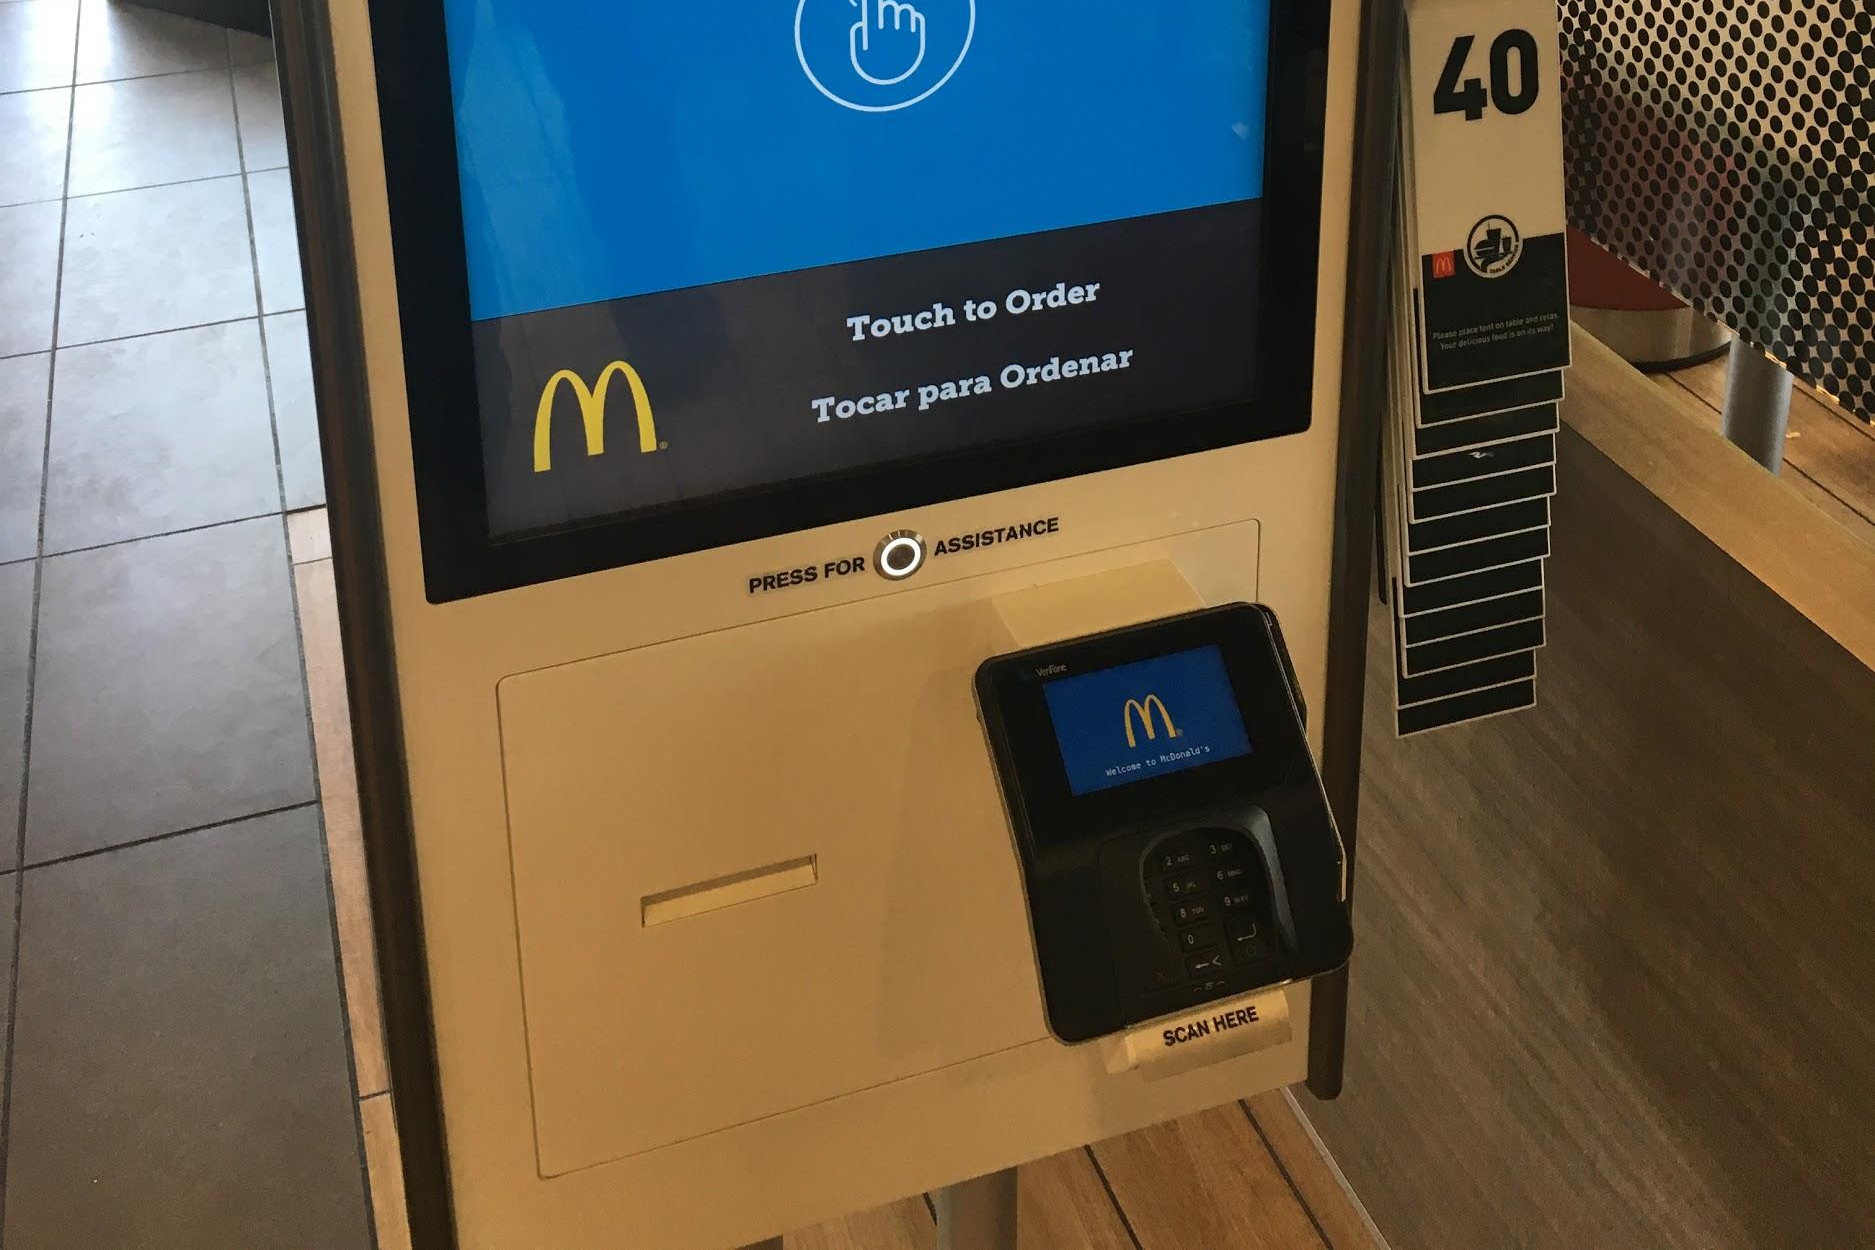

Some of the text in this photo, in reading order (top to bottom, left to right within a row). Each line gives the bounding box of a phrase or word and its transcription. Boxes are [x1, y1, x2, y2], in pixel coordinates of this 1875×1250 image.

[1434, 29, 1539, 121] 40
[847, 283, 1099, 341] Touch to Order
[1432, 330, 1458, 340] Please
[1459, 326, 1478, 337] place
[1506, 318, 1524, 327] table
[1525, 315, 1539, 324] and
[1440, 341, 1456, 350] Your
[1458, 336, 1491, 348] delicious
[1492, 332, 1508, 341] food
[812, 350, 1133, 422] Tocar para Ordenar
[749, 517, 1059, 594] PRESS FOR ASSISTANCE
[1105, 745, 1211, 777] Welcome to McDonald's
[1165, 856, 1173, 866] 2
[1172, 882, 1180, 893] 5
[1216, 870, 1224, 880] 6
[1179, 907, 1187, 919] 8
[1224, 896, 1231, 907] 9
[1163, 1006, 1258, 1046] SCAN HERE
